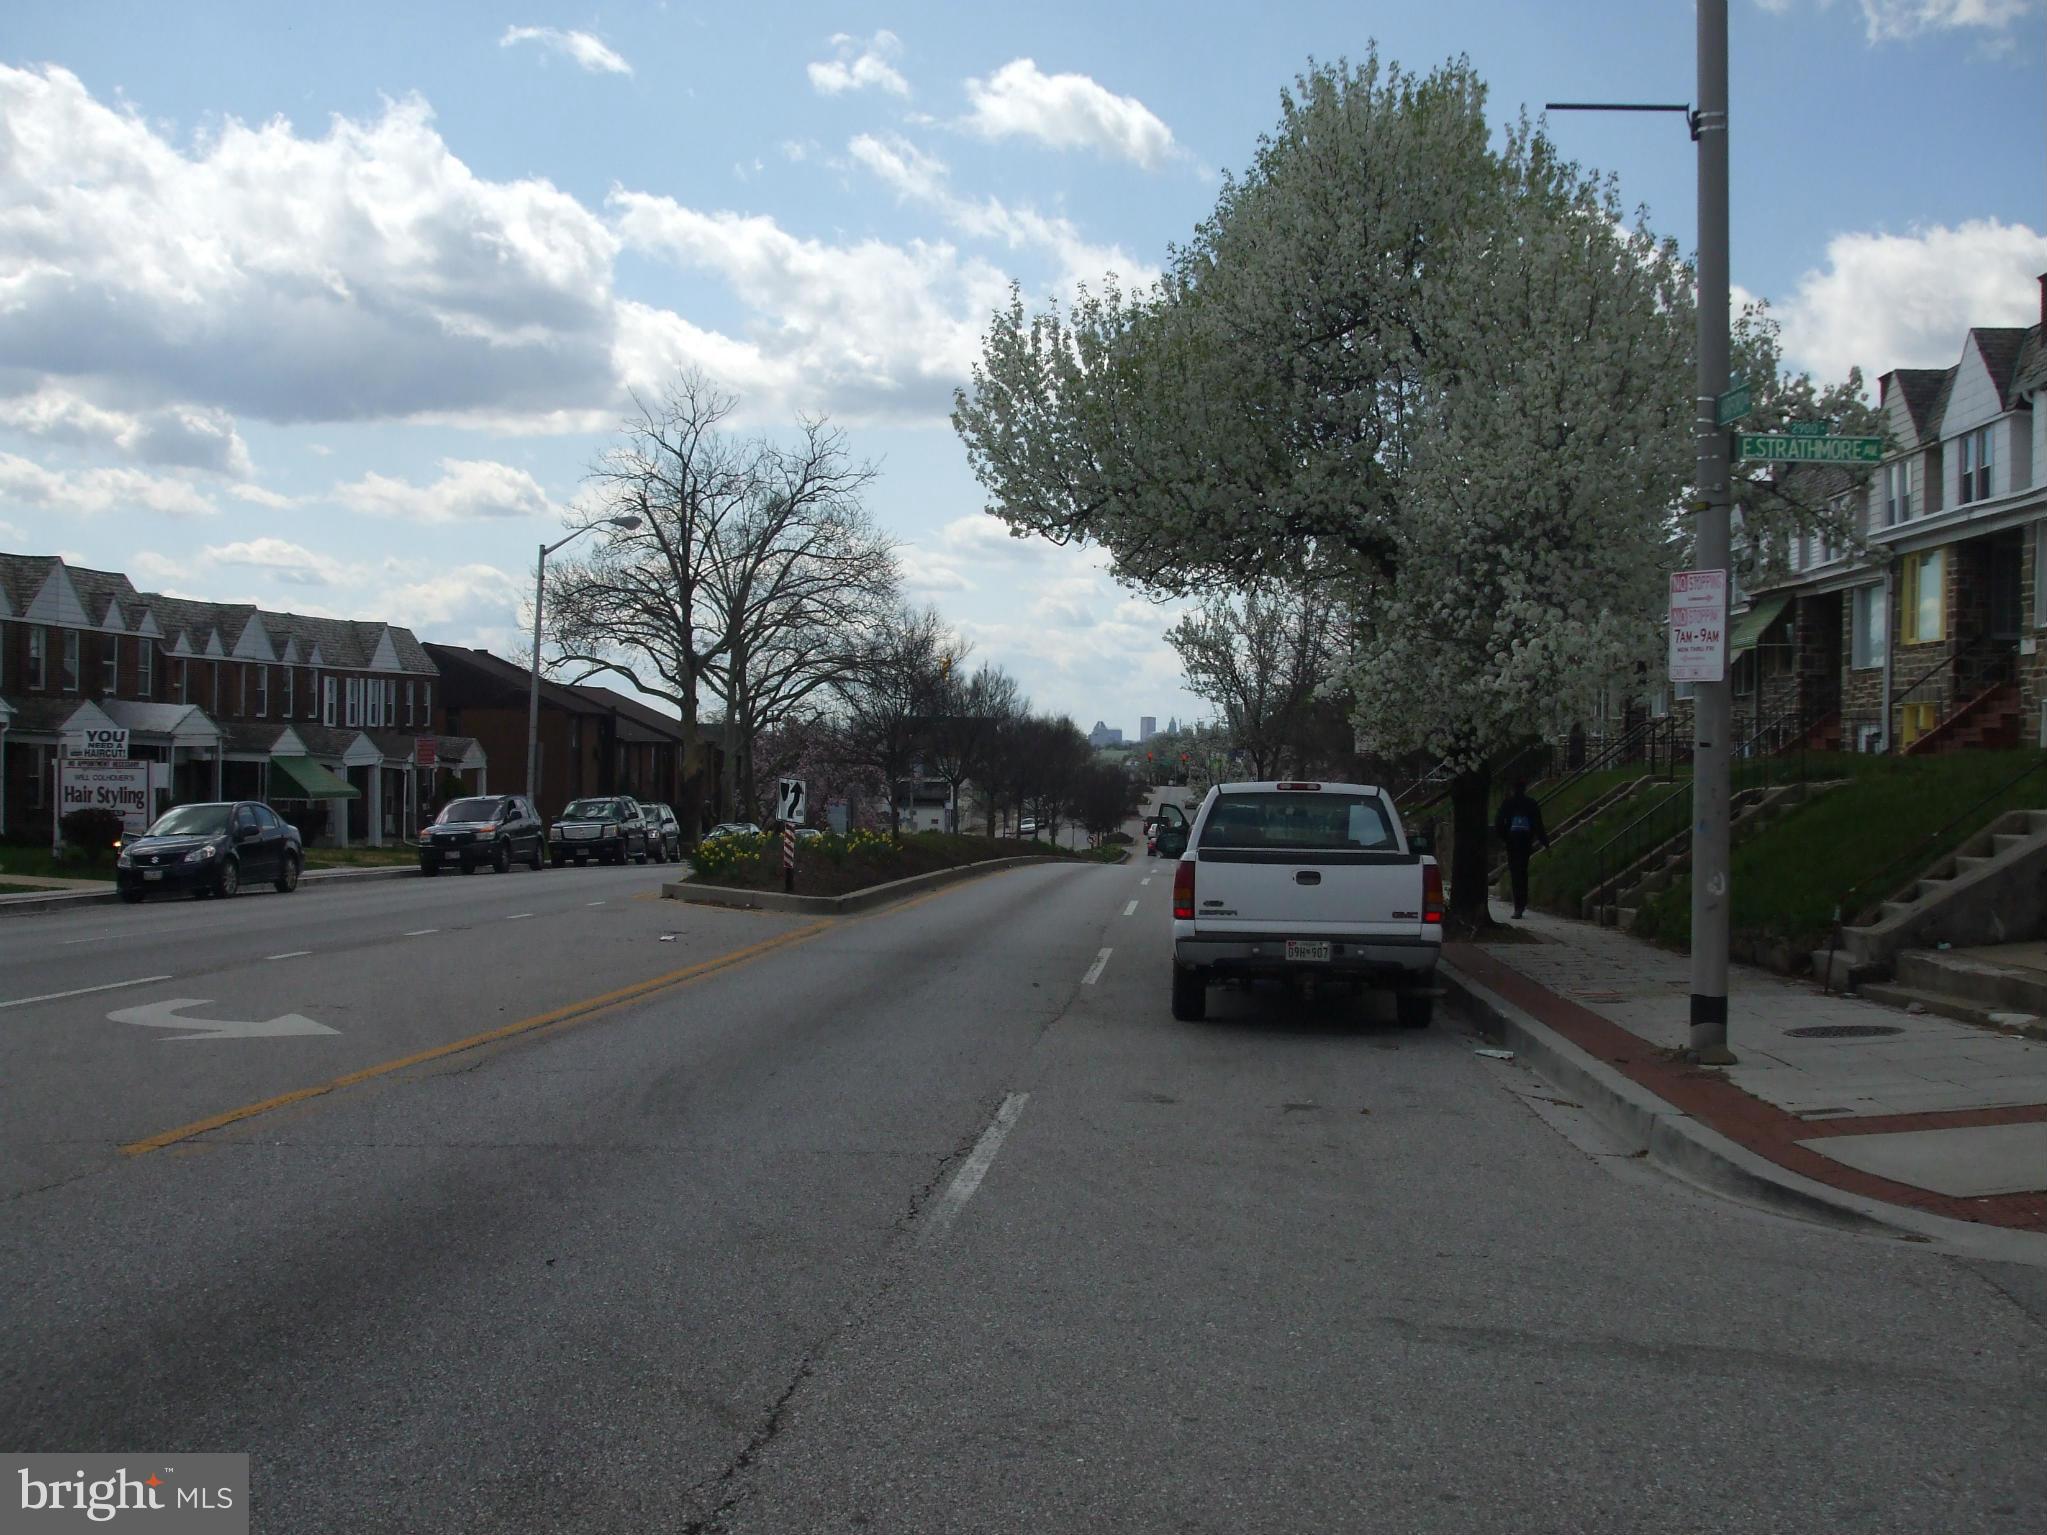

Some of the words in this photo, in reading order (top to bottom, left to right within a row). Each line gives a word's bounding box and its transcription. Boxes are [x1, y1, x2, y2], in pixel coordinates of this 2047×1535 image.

[1672, 575, 1687, 592] NO
[1671, 609, 1687, 626] NO
[86, 730, 126, 743] YOU
[84, 749, 126, 758] HAIRCUT!
[64, 785, 93, 803] Hair
[97, 785, 145, 809] Styling
